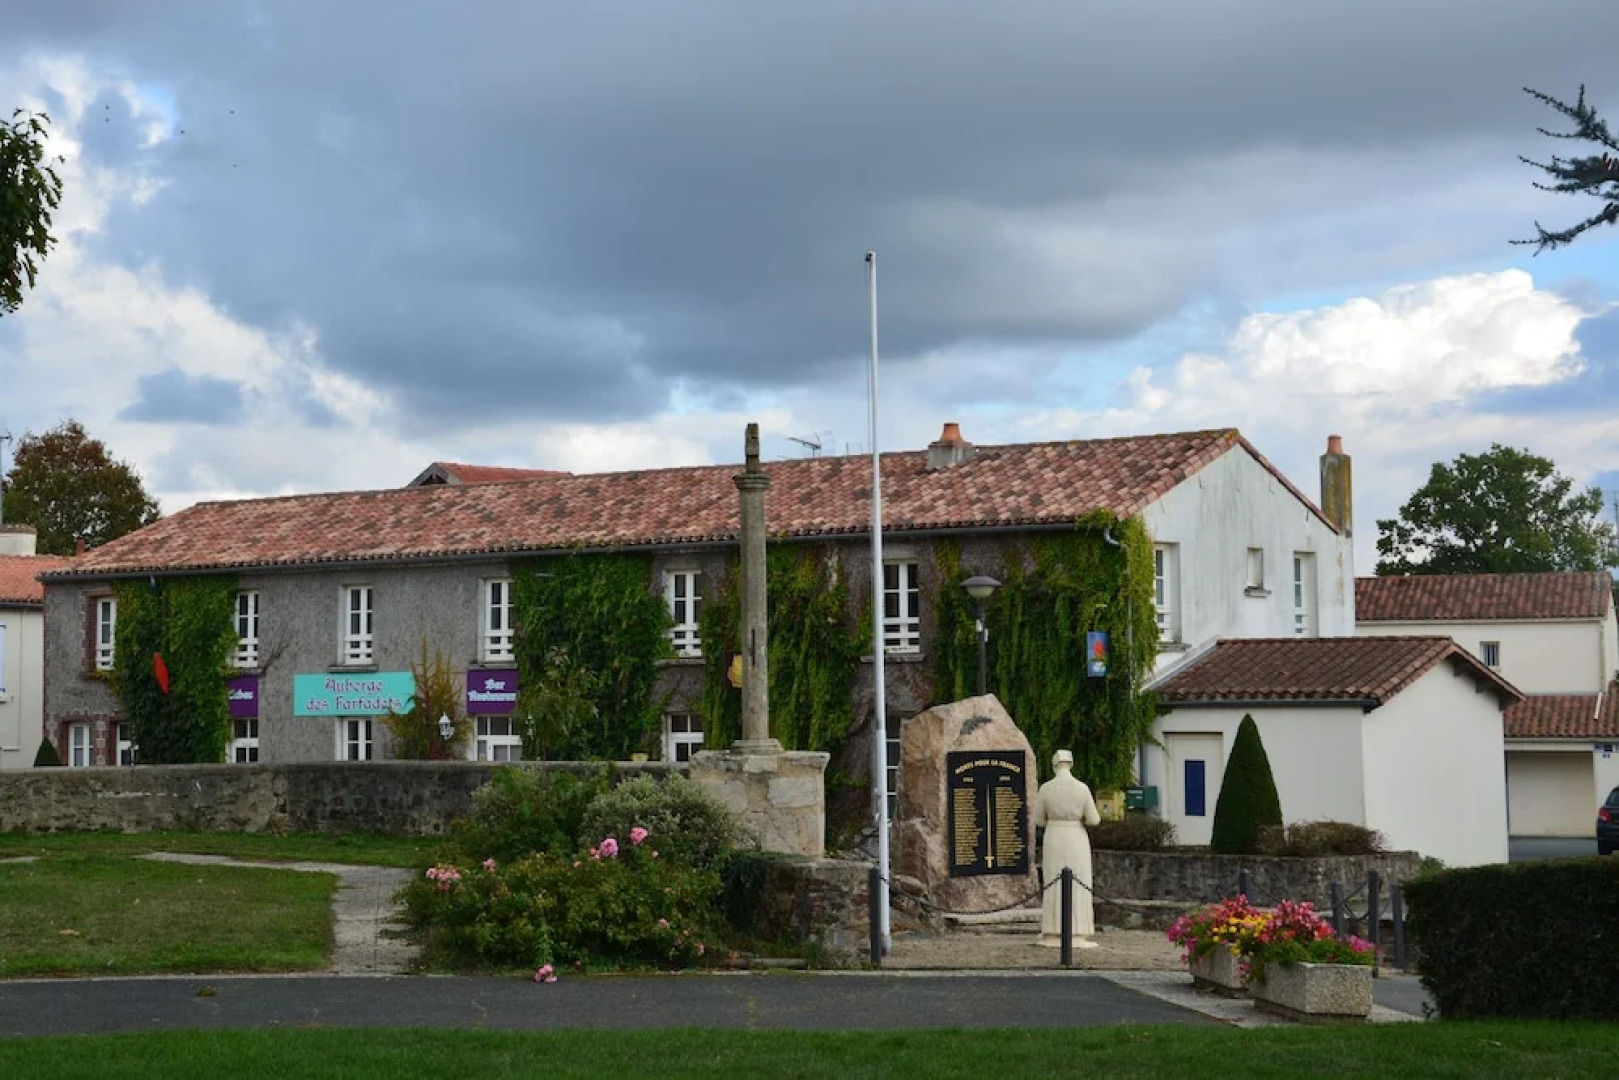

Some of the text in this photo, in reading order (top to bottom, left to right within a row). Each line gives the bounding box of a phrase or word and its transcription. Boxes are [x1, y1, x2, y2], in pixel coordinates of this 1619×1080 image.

[325, 678, 382, 694] Auberge
[484, 678, 505, 690] Bar
[306, 696, 401, 710] des Farfadets
